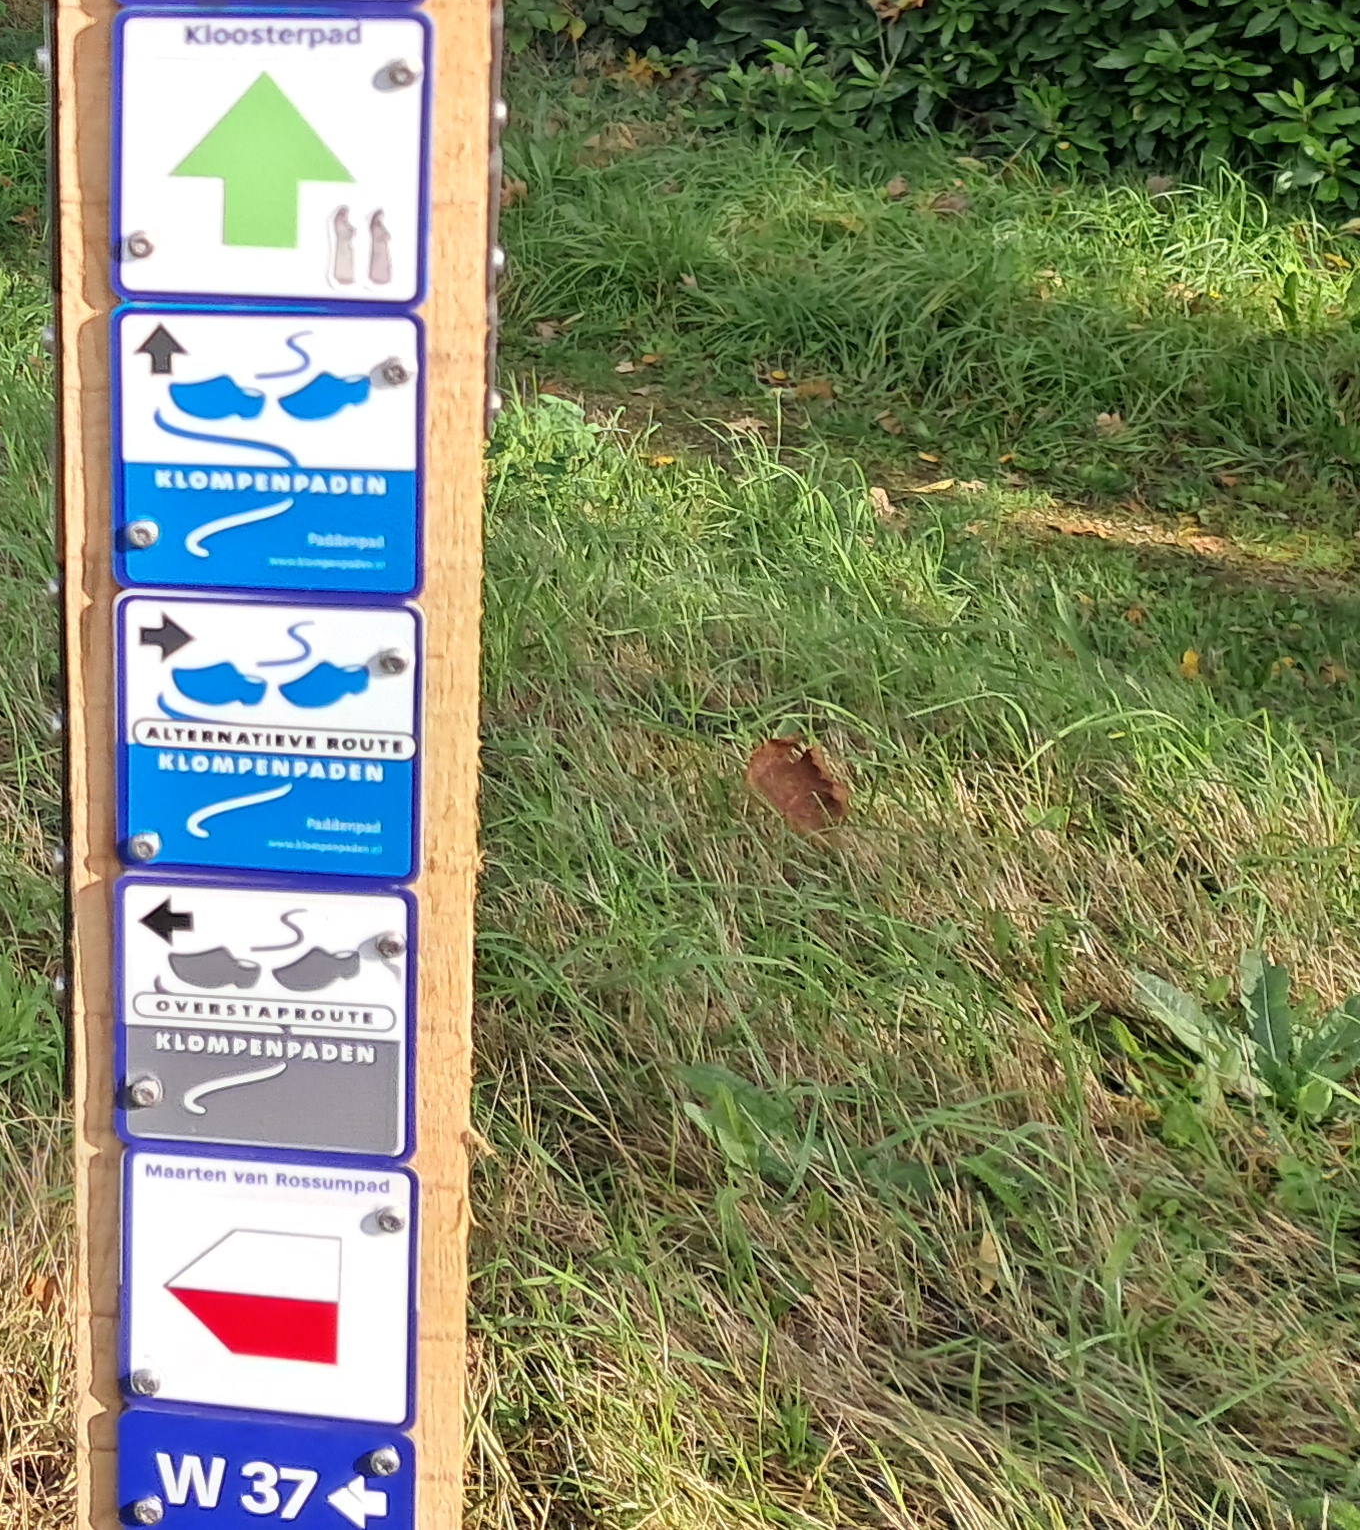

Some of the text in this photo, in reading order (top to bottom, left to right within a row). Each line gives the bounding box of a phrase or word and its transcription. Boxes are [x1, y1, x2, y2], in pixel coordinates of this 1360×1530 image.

[184, 22, 362, 50] Kloosterpad
[154, 469, 387, 495] KLOMPENPADEN
[146, 726, 403, 754] ALTERNATIEVE ROUTE
[158, 752, 384, 782] KLOMPENPADEN
[156, 999, 374, 1025] OVERSTAPROUTE
[154, 1032, 376, 1065] KLOMPENPADEN
[145, 1163, 390, 1195] Maarten van Rossumpad
[156, 1452, 319, 1521] W 37
